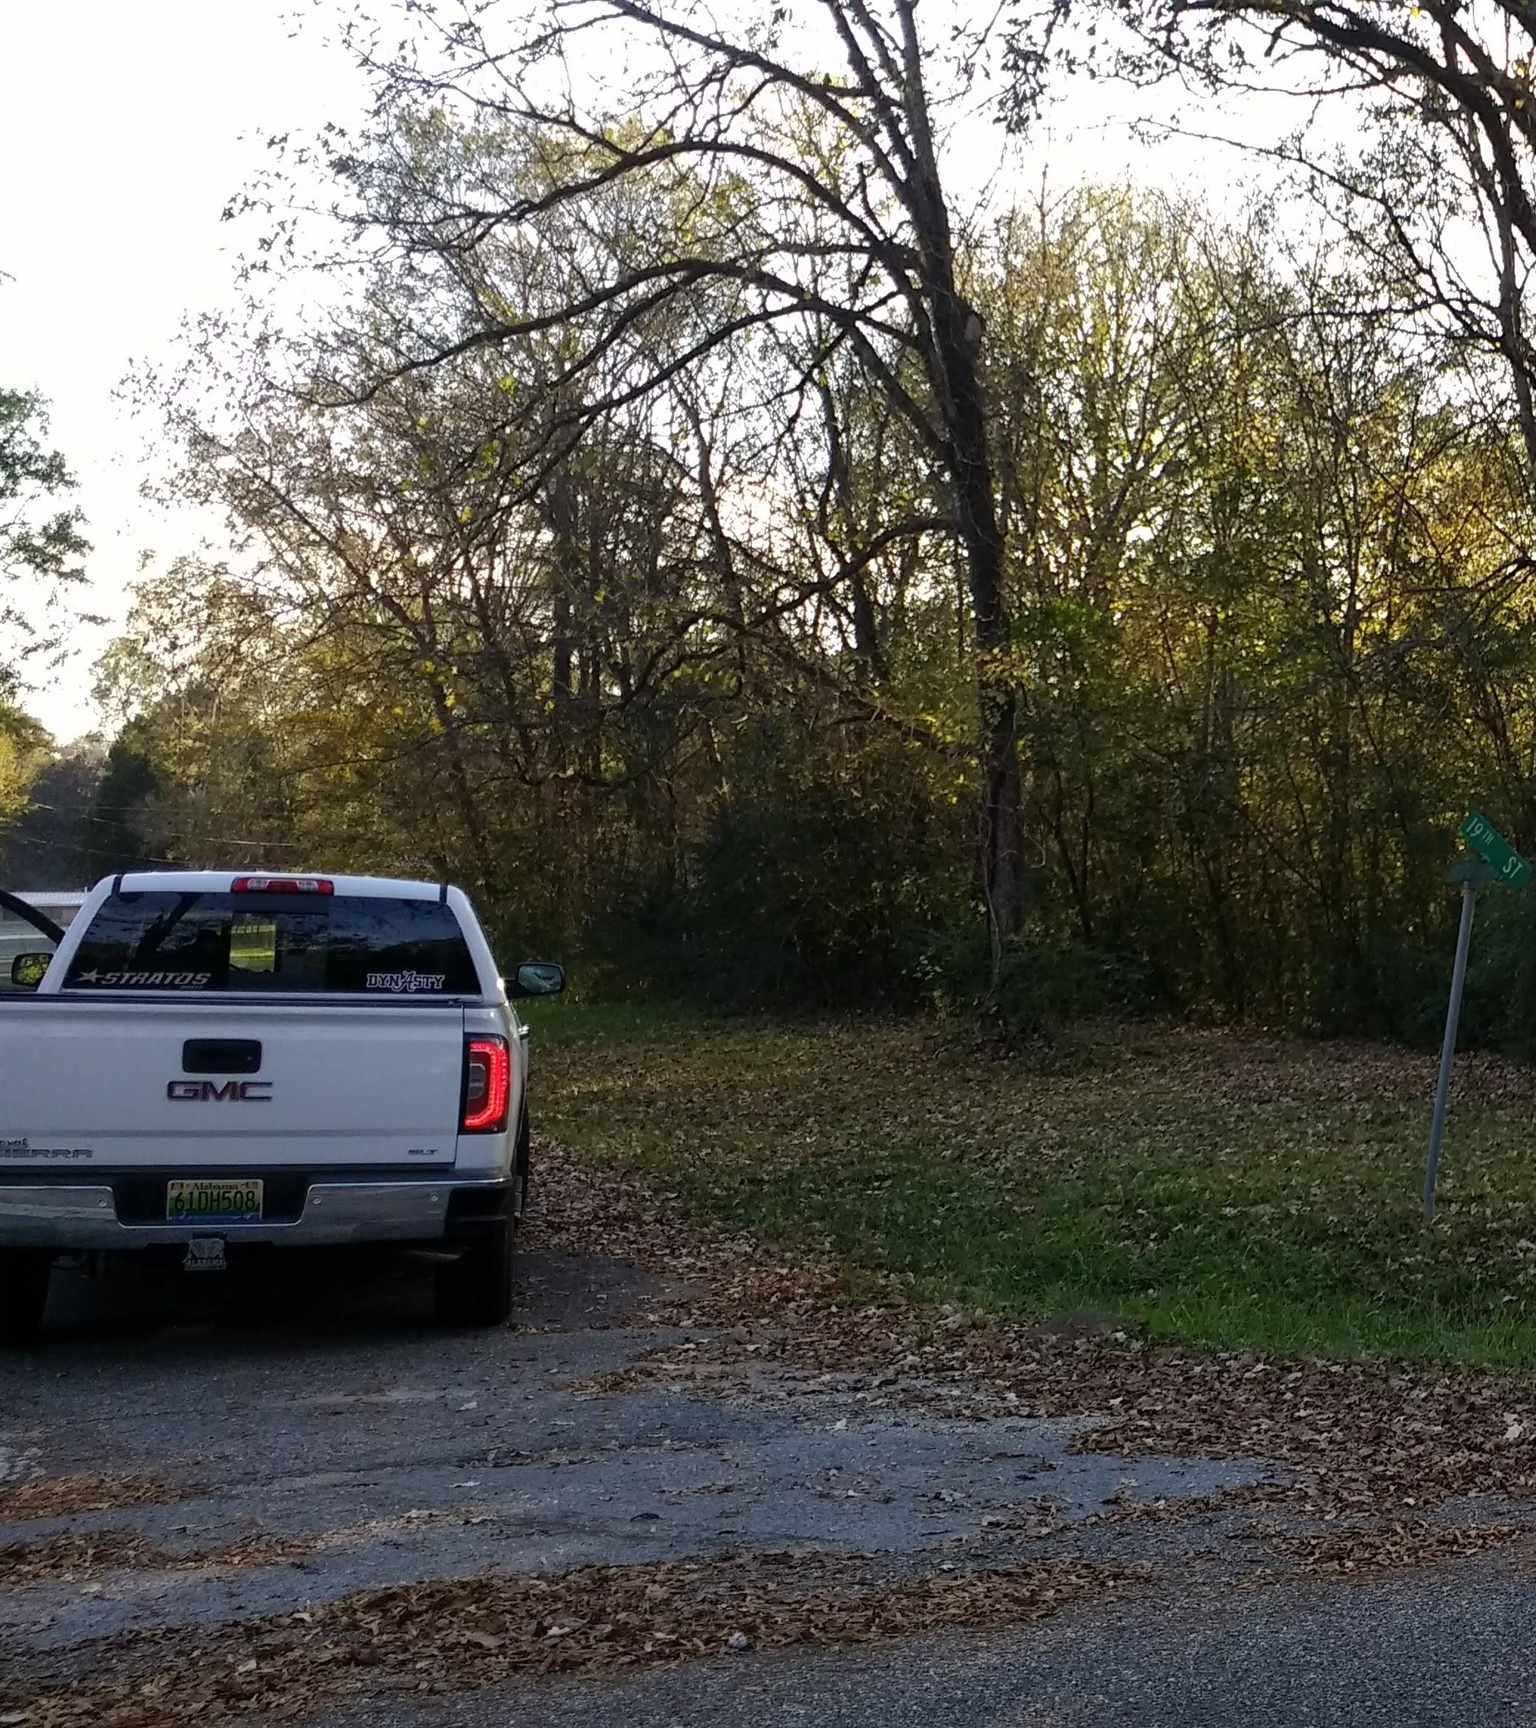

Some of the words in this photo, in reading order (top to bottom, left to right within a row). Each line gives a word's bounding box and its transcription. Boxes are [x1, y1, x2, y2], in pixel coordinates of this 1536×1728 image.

[1466, 817, 1496, 846] 19TH
[1502, 856, 1523, 879] ST
[101, 972, 211, 985] STRATOS
[366, 970, 445, 992] DYNASTY
[167, 1081, 273, 1101] GMC
[193, 1182, 238, 1190] Alabama
[175, 1190, 256, 1210] 61DH508
